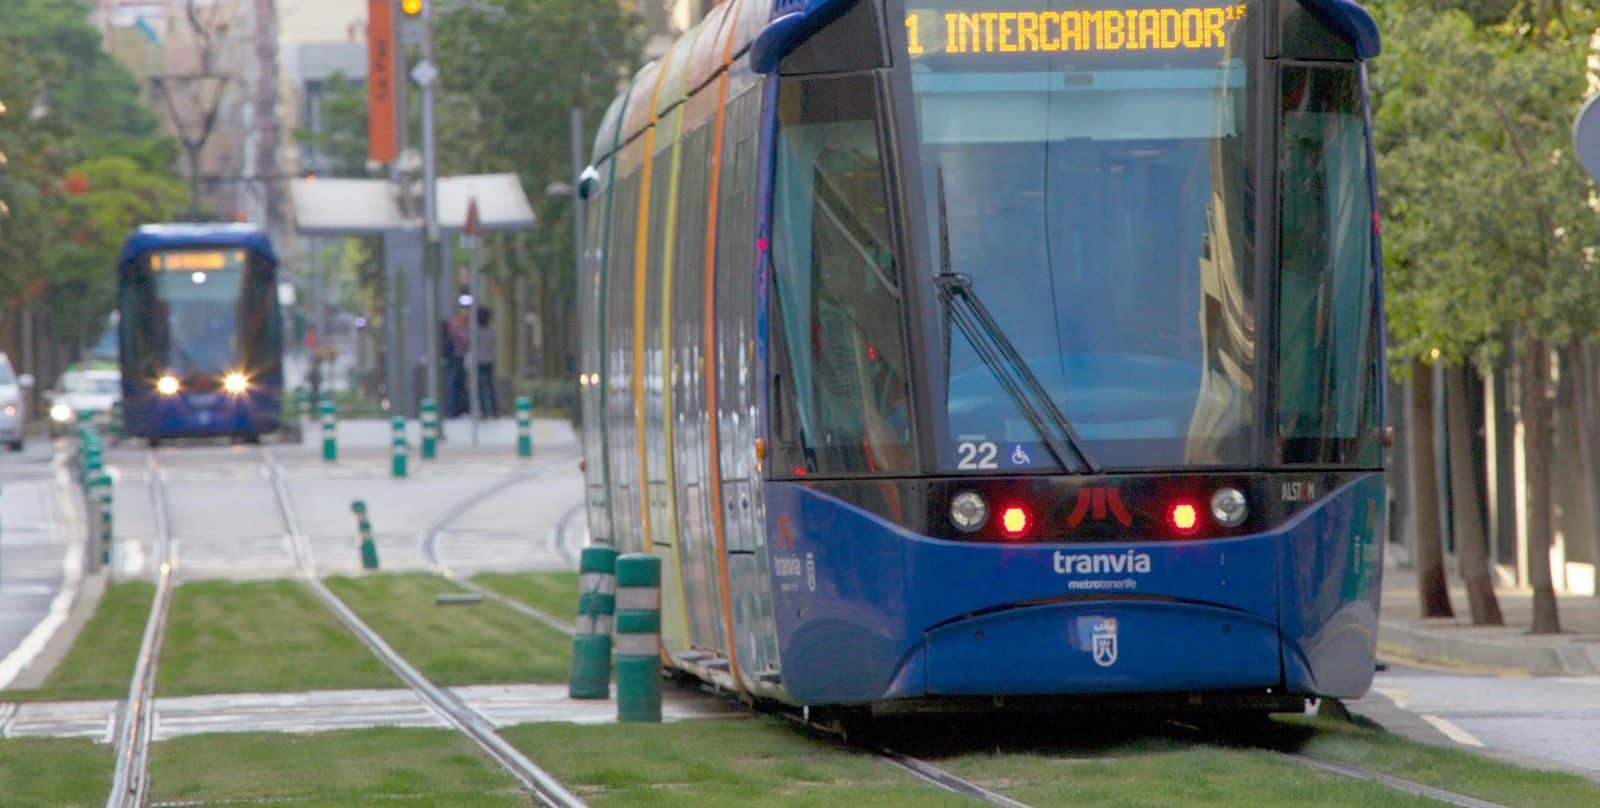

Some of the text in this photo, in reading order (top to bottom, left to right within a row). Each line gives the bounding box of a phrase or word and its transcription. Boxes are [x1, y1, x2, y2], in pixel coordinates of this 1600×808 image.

[905, 14, 924, 55] 1
[945, 8, 1225, 53] INTERCAMBIADOR
[957, 441, 998, 470] 22
[1053, 549, 1151, 574] tranvía
[1067, 578, 1137, 590] metrotenerife
